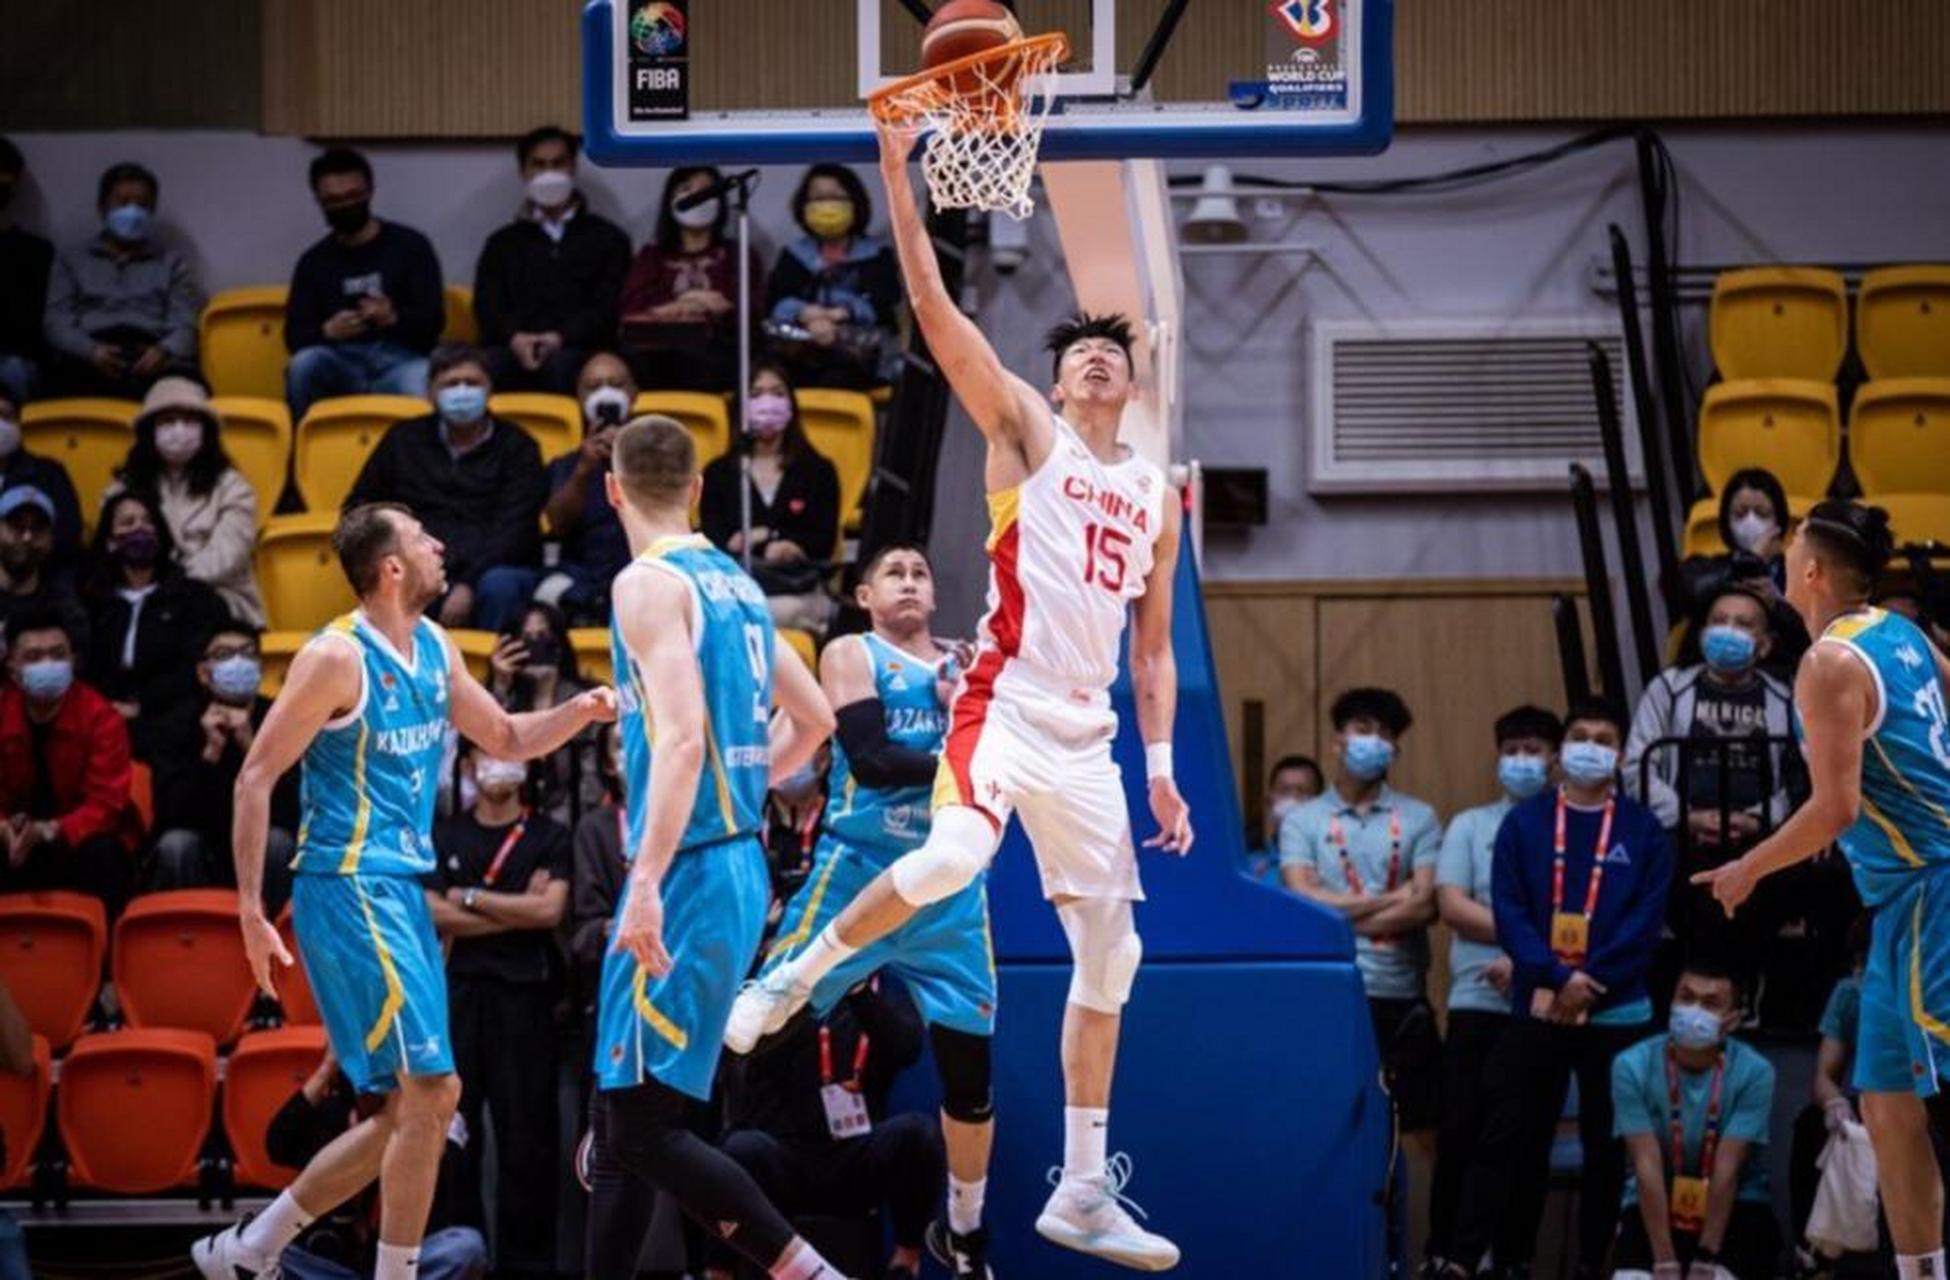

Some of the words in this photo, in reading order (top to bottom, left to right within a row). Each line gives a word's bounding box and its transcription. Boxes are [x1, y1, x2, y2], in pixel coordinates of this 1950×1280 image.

[636, 68, 680, 90] FIBA
[1266, 71, 1315, 82] WORLD
[1317, 71, 1345, 82] CUP
[1268, 84, 1344, 95] QUALIFIERS
[1063, 475, 1147, 534] CHINA
[1084, 522, 1132, 593] 15
